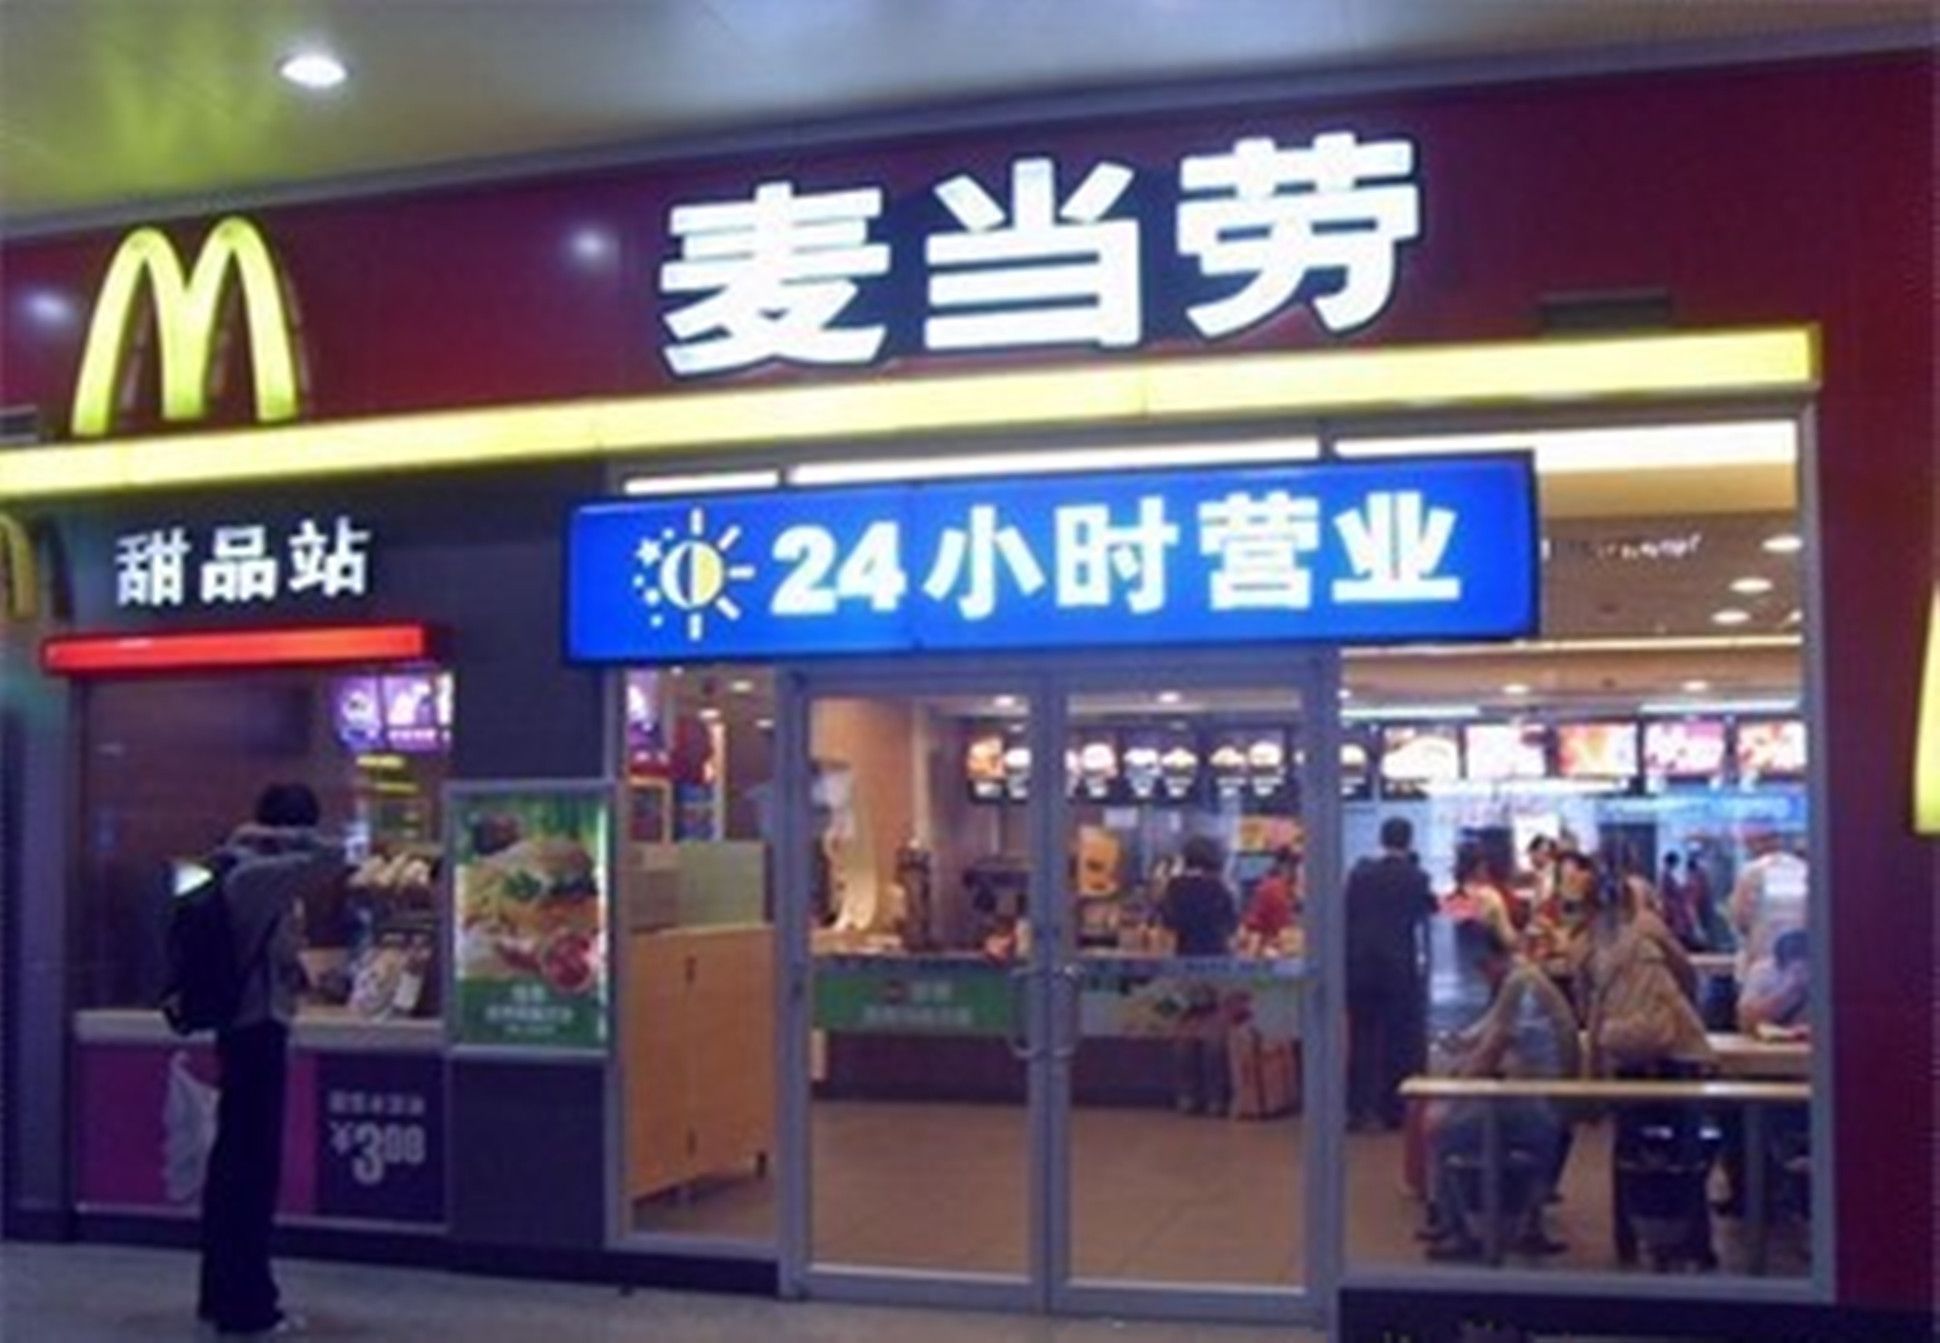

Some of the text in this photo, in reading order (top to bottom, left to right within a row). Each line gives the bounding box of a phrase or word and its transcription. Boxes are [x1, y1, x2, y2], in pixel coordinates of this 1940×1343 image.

[660, 132, 1419, 374] 麦当劳
[115, 516, 371, 606] 甜品站
[770, 490, 1462, 619] 24小时营业
